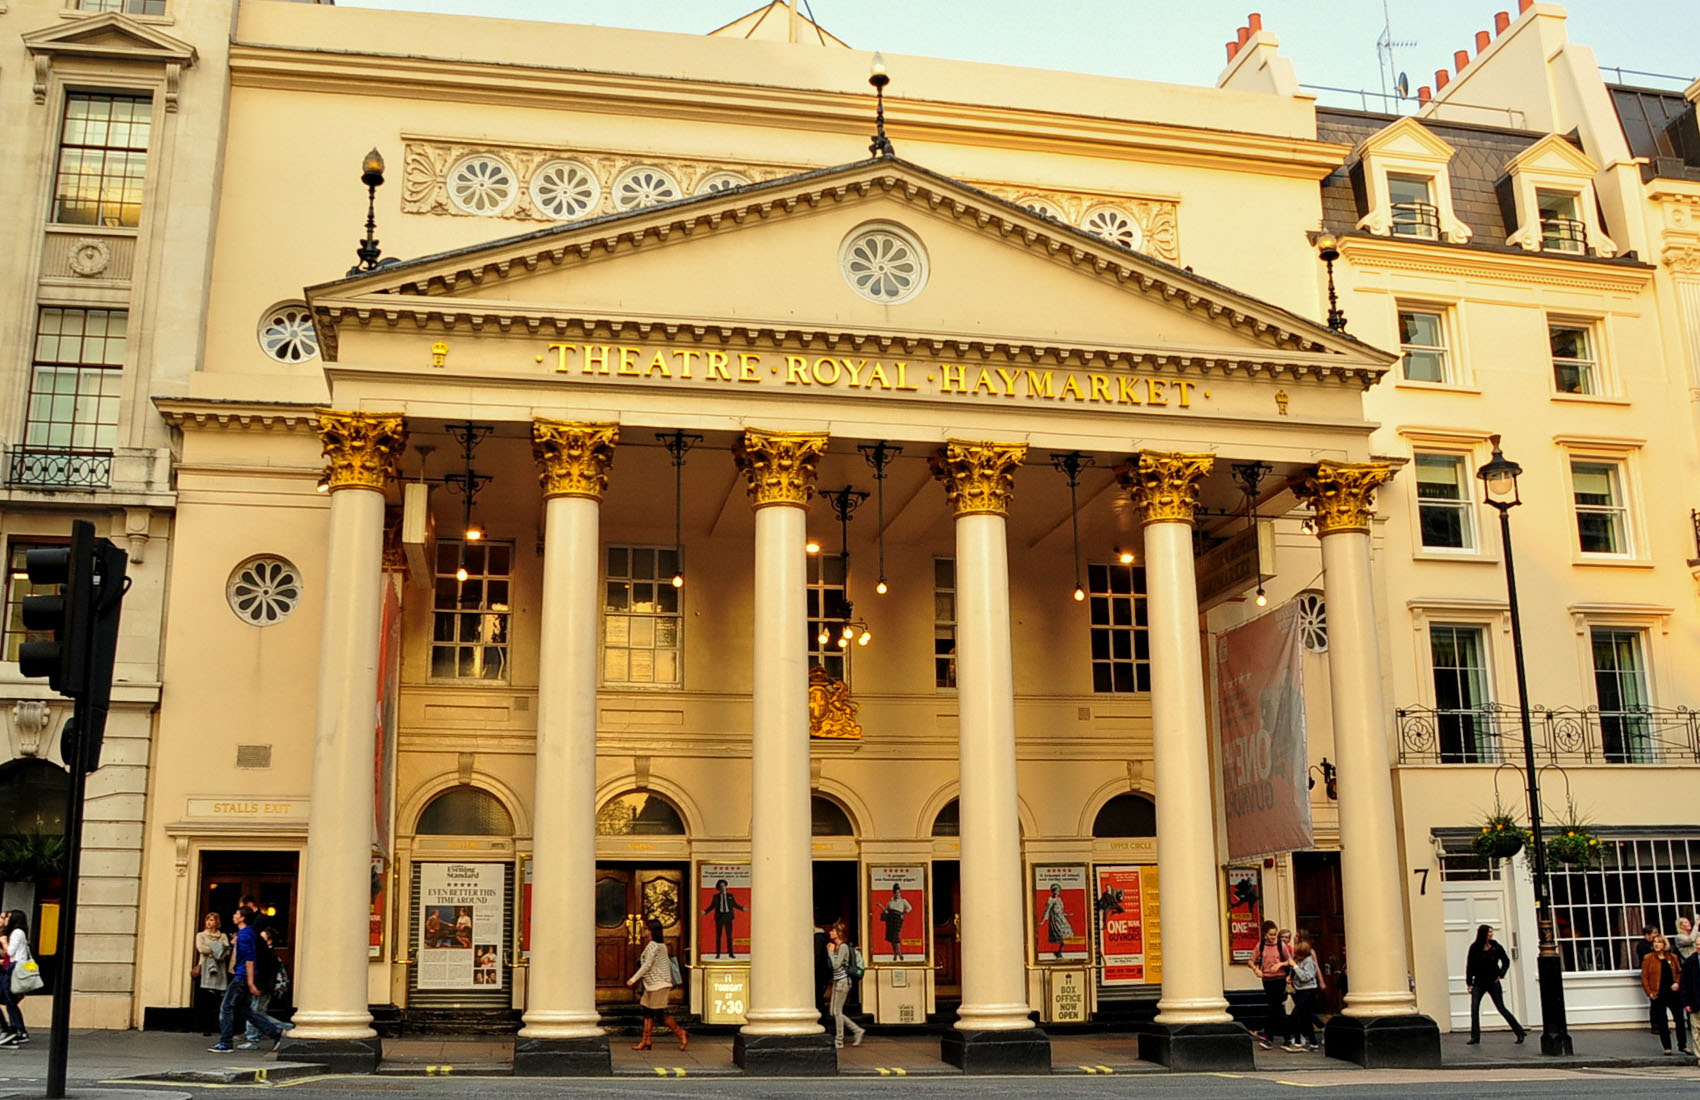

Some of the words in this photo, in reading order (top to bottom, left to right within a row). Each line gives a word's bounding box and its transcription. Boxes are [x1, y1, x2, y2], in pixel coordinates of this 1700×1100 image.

[549, 343, 762, 382] THEATRE
[785, 355, 919, 391] ROYAL
[939, 363, 1197, 408] HAYMARKET
[214, 803, 258, 814] STALLS
[264, 803, 292, 814] EXIT
[447, 866, 476, 874] Evening
[1413, 868, 1430, 896] 7
[428, 888, 449, 896] EVEN
[449, 888, 478, 896] BETTER
[480, 888, 496, 896] THIS
[437, 896, 458, 904] TIME
[457, 896, 488, 904] AROUND
[1107, 919, 1128, 934] ONE
[1231, 922, 1248, 933] ONE
[1060, 985, 1076, 994] BOX
[1055, 994, 1082, 1003] OFFICE
[1060, 1003, 1078, 1011] NOW
[1058, 1011, 1079, 1020] OPEN
